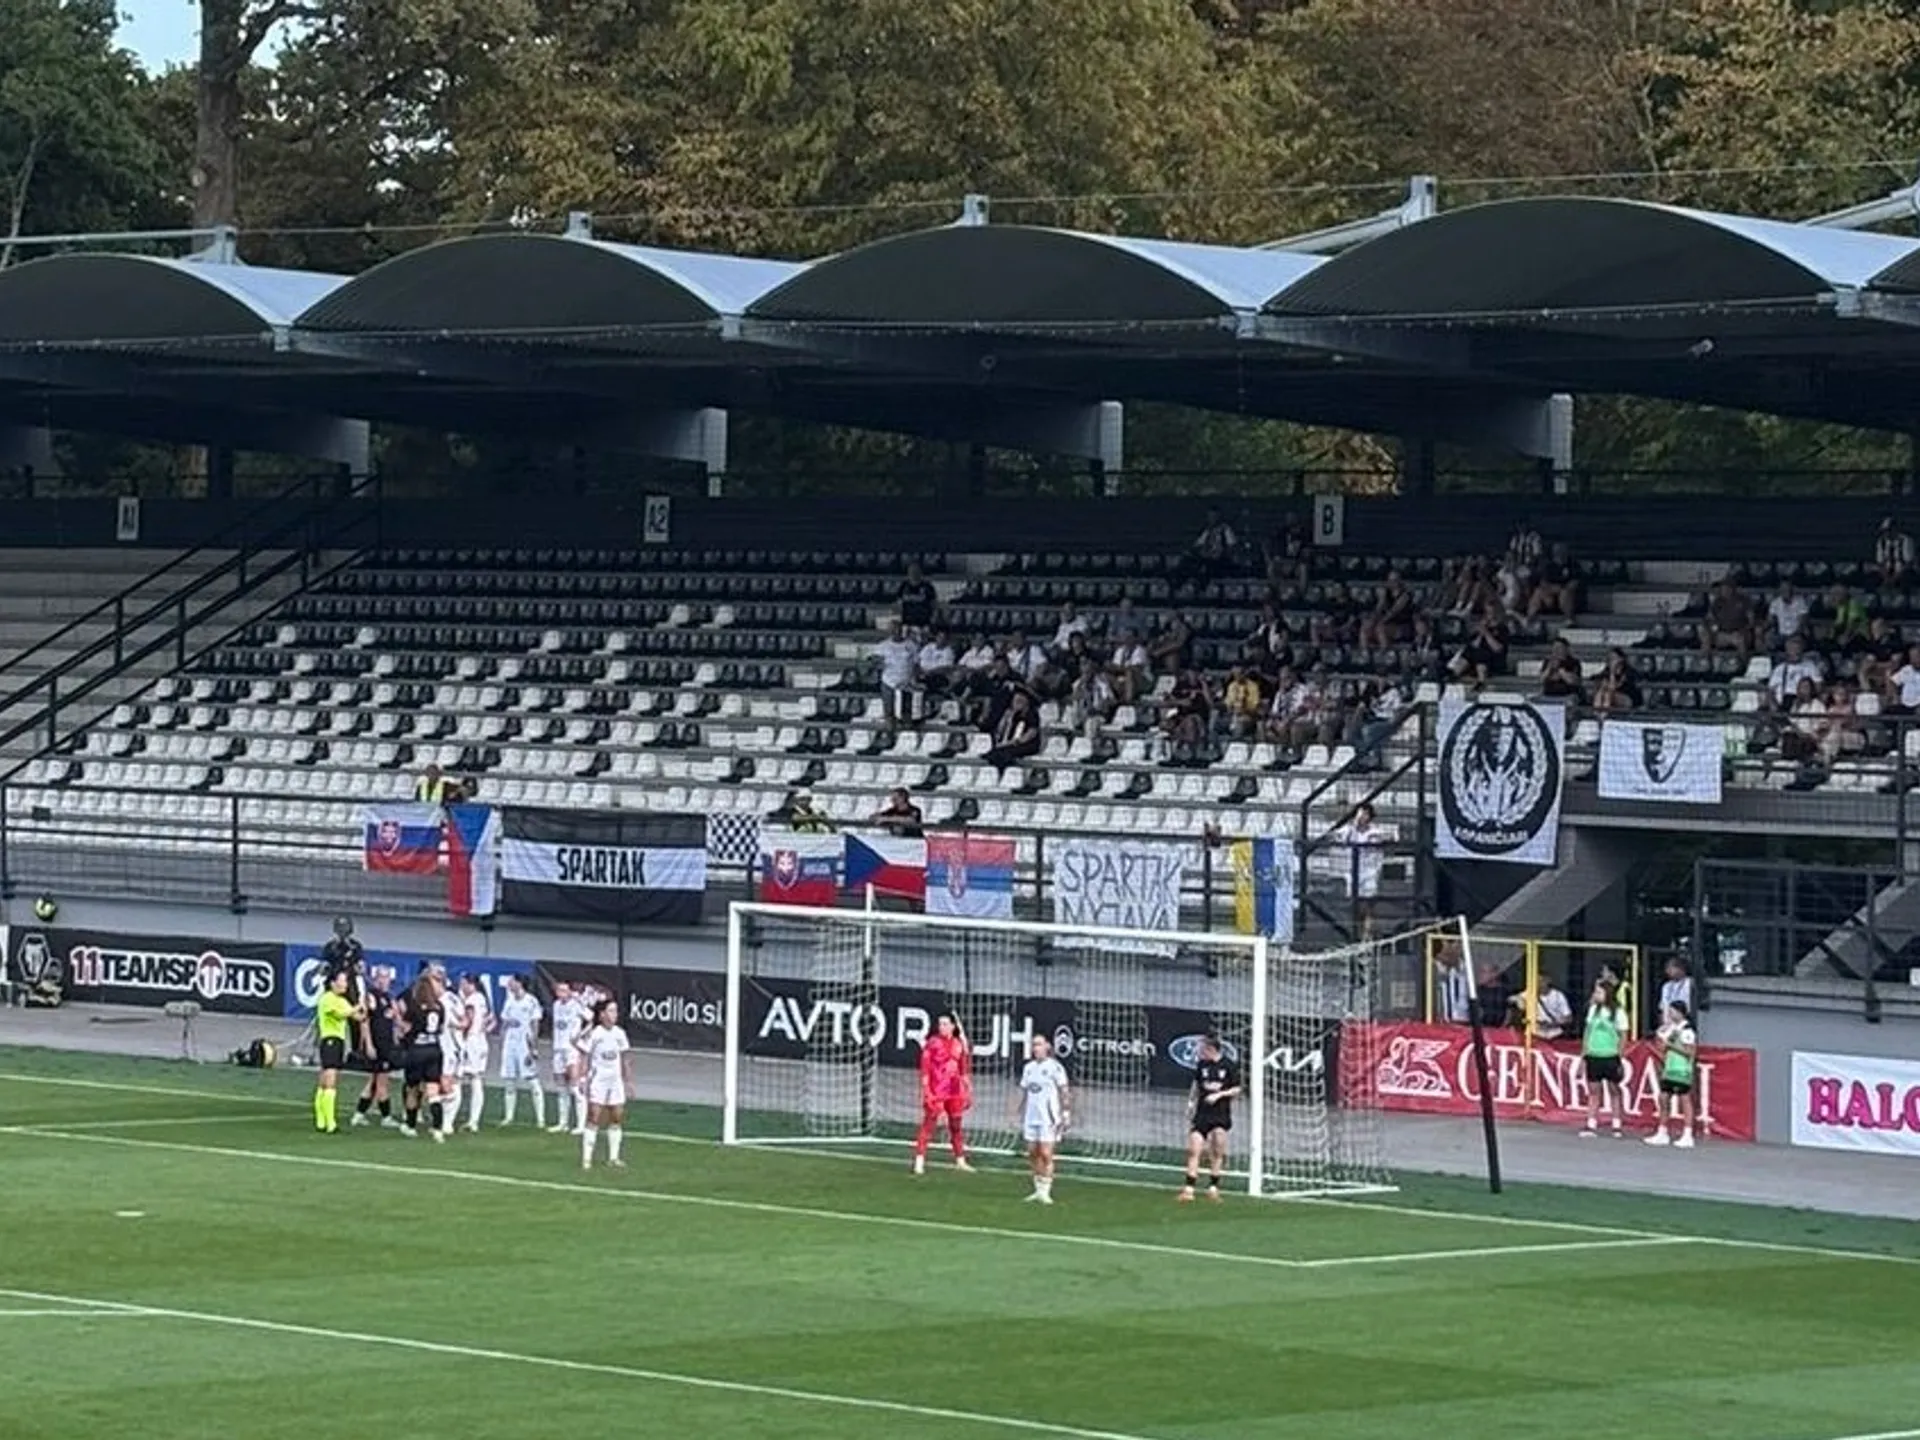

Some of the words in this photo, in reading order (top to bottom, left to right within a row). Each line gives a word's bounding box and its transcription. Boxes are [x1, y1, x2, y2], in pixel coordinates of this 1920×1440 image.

[649, 503, 669, 533] A2
[1322, 503, 1336, 537] B
[557, 847, 646, 886] SPARTAK
[1060, 847, 1180, 904] SPARTAK
[629, 993, 723, 1026] kodila.si
[759, 996, 886, 1046] AVTO
[898, 1006, 1034, 1060] RJH
